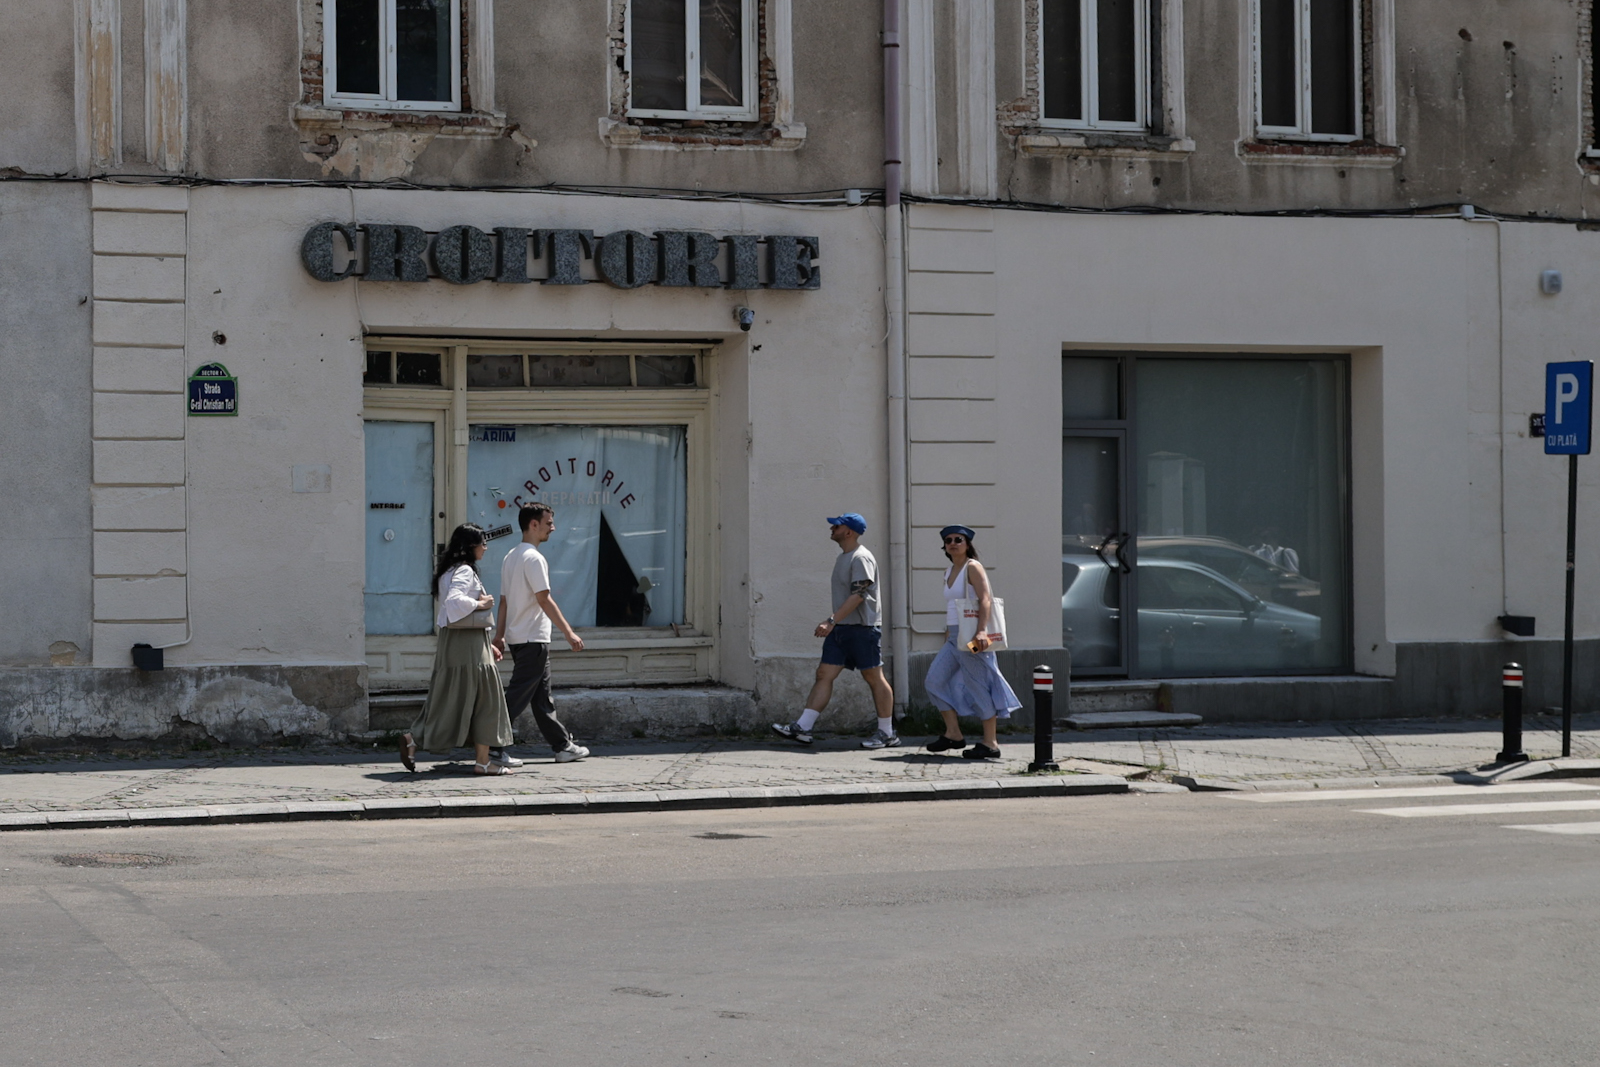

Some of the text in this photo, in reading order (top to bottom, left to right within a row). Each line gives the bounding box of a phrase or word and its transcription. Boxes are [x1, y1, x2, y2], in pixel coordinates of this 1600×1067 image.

[301, 221, 821, 291] CROITORIE
[204, 383, 221, 394] Strada
[190, 398, 234, 410] G-ral Christian Tell
[1555, 373, 1579, 424] P
[483, 427, 516, 442] ARTIM
[1548, 435, 1556, 446] CU
